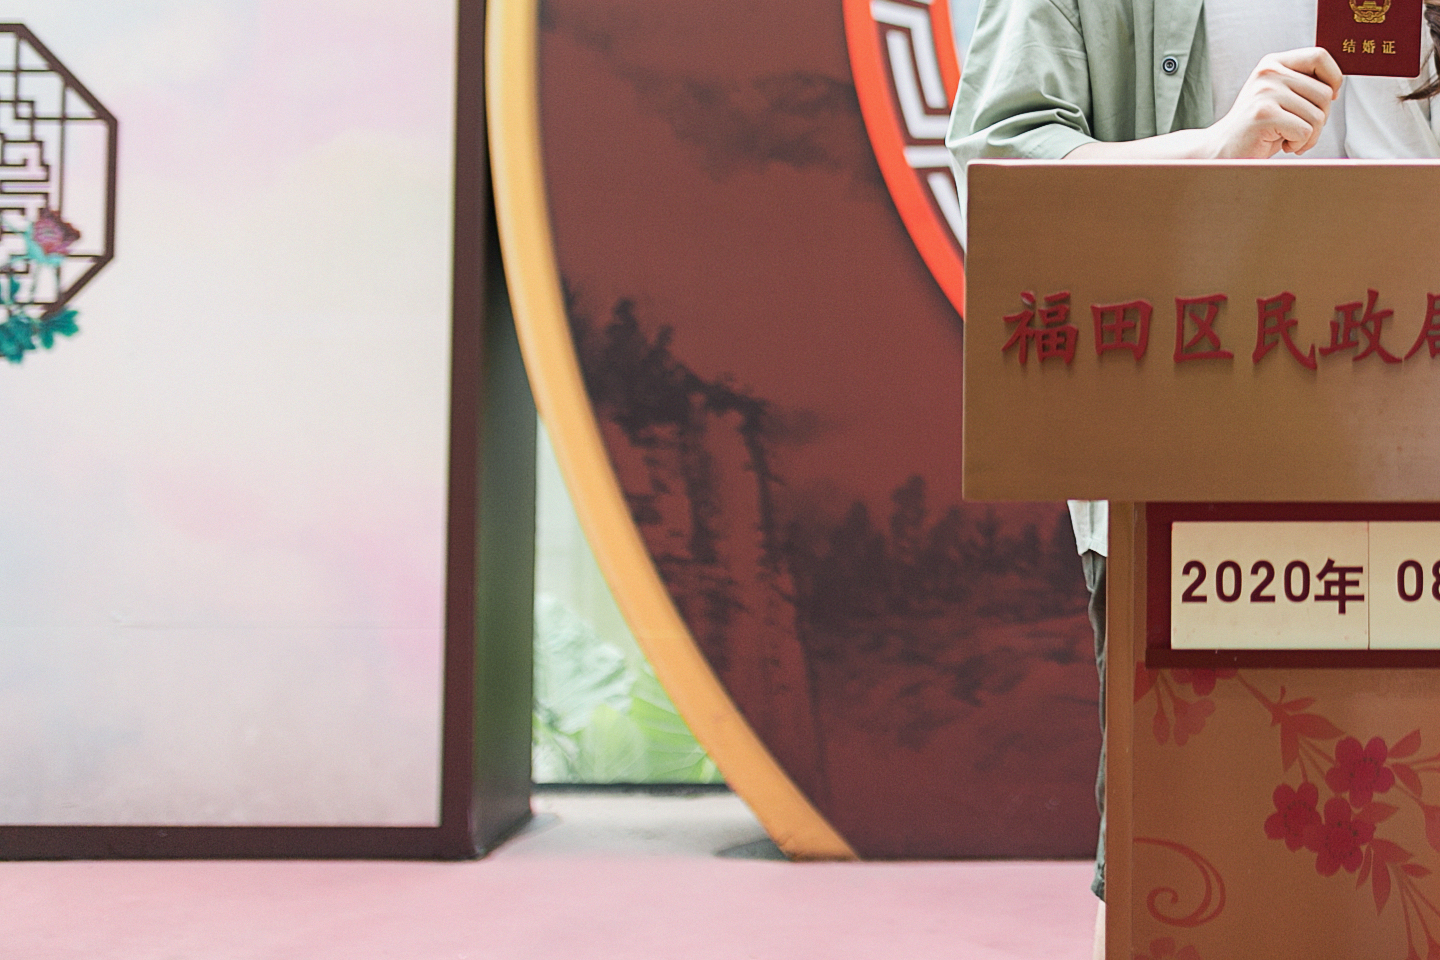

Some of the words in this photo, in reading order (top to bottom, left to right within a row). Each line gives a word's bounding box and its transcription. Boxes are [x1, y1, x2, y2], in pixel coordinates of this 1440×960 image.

[1342, 38, 1397, 55] 结婚证
[1181, 557, 1366, 615] 2020年
